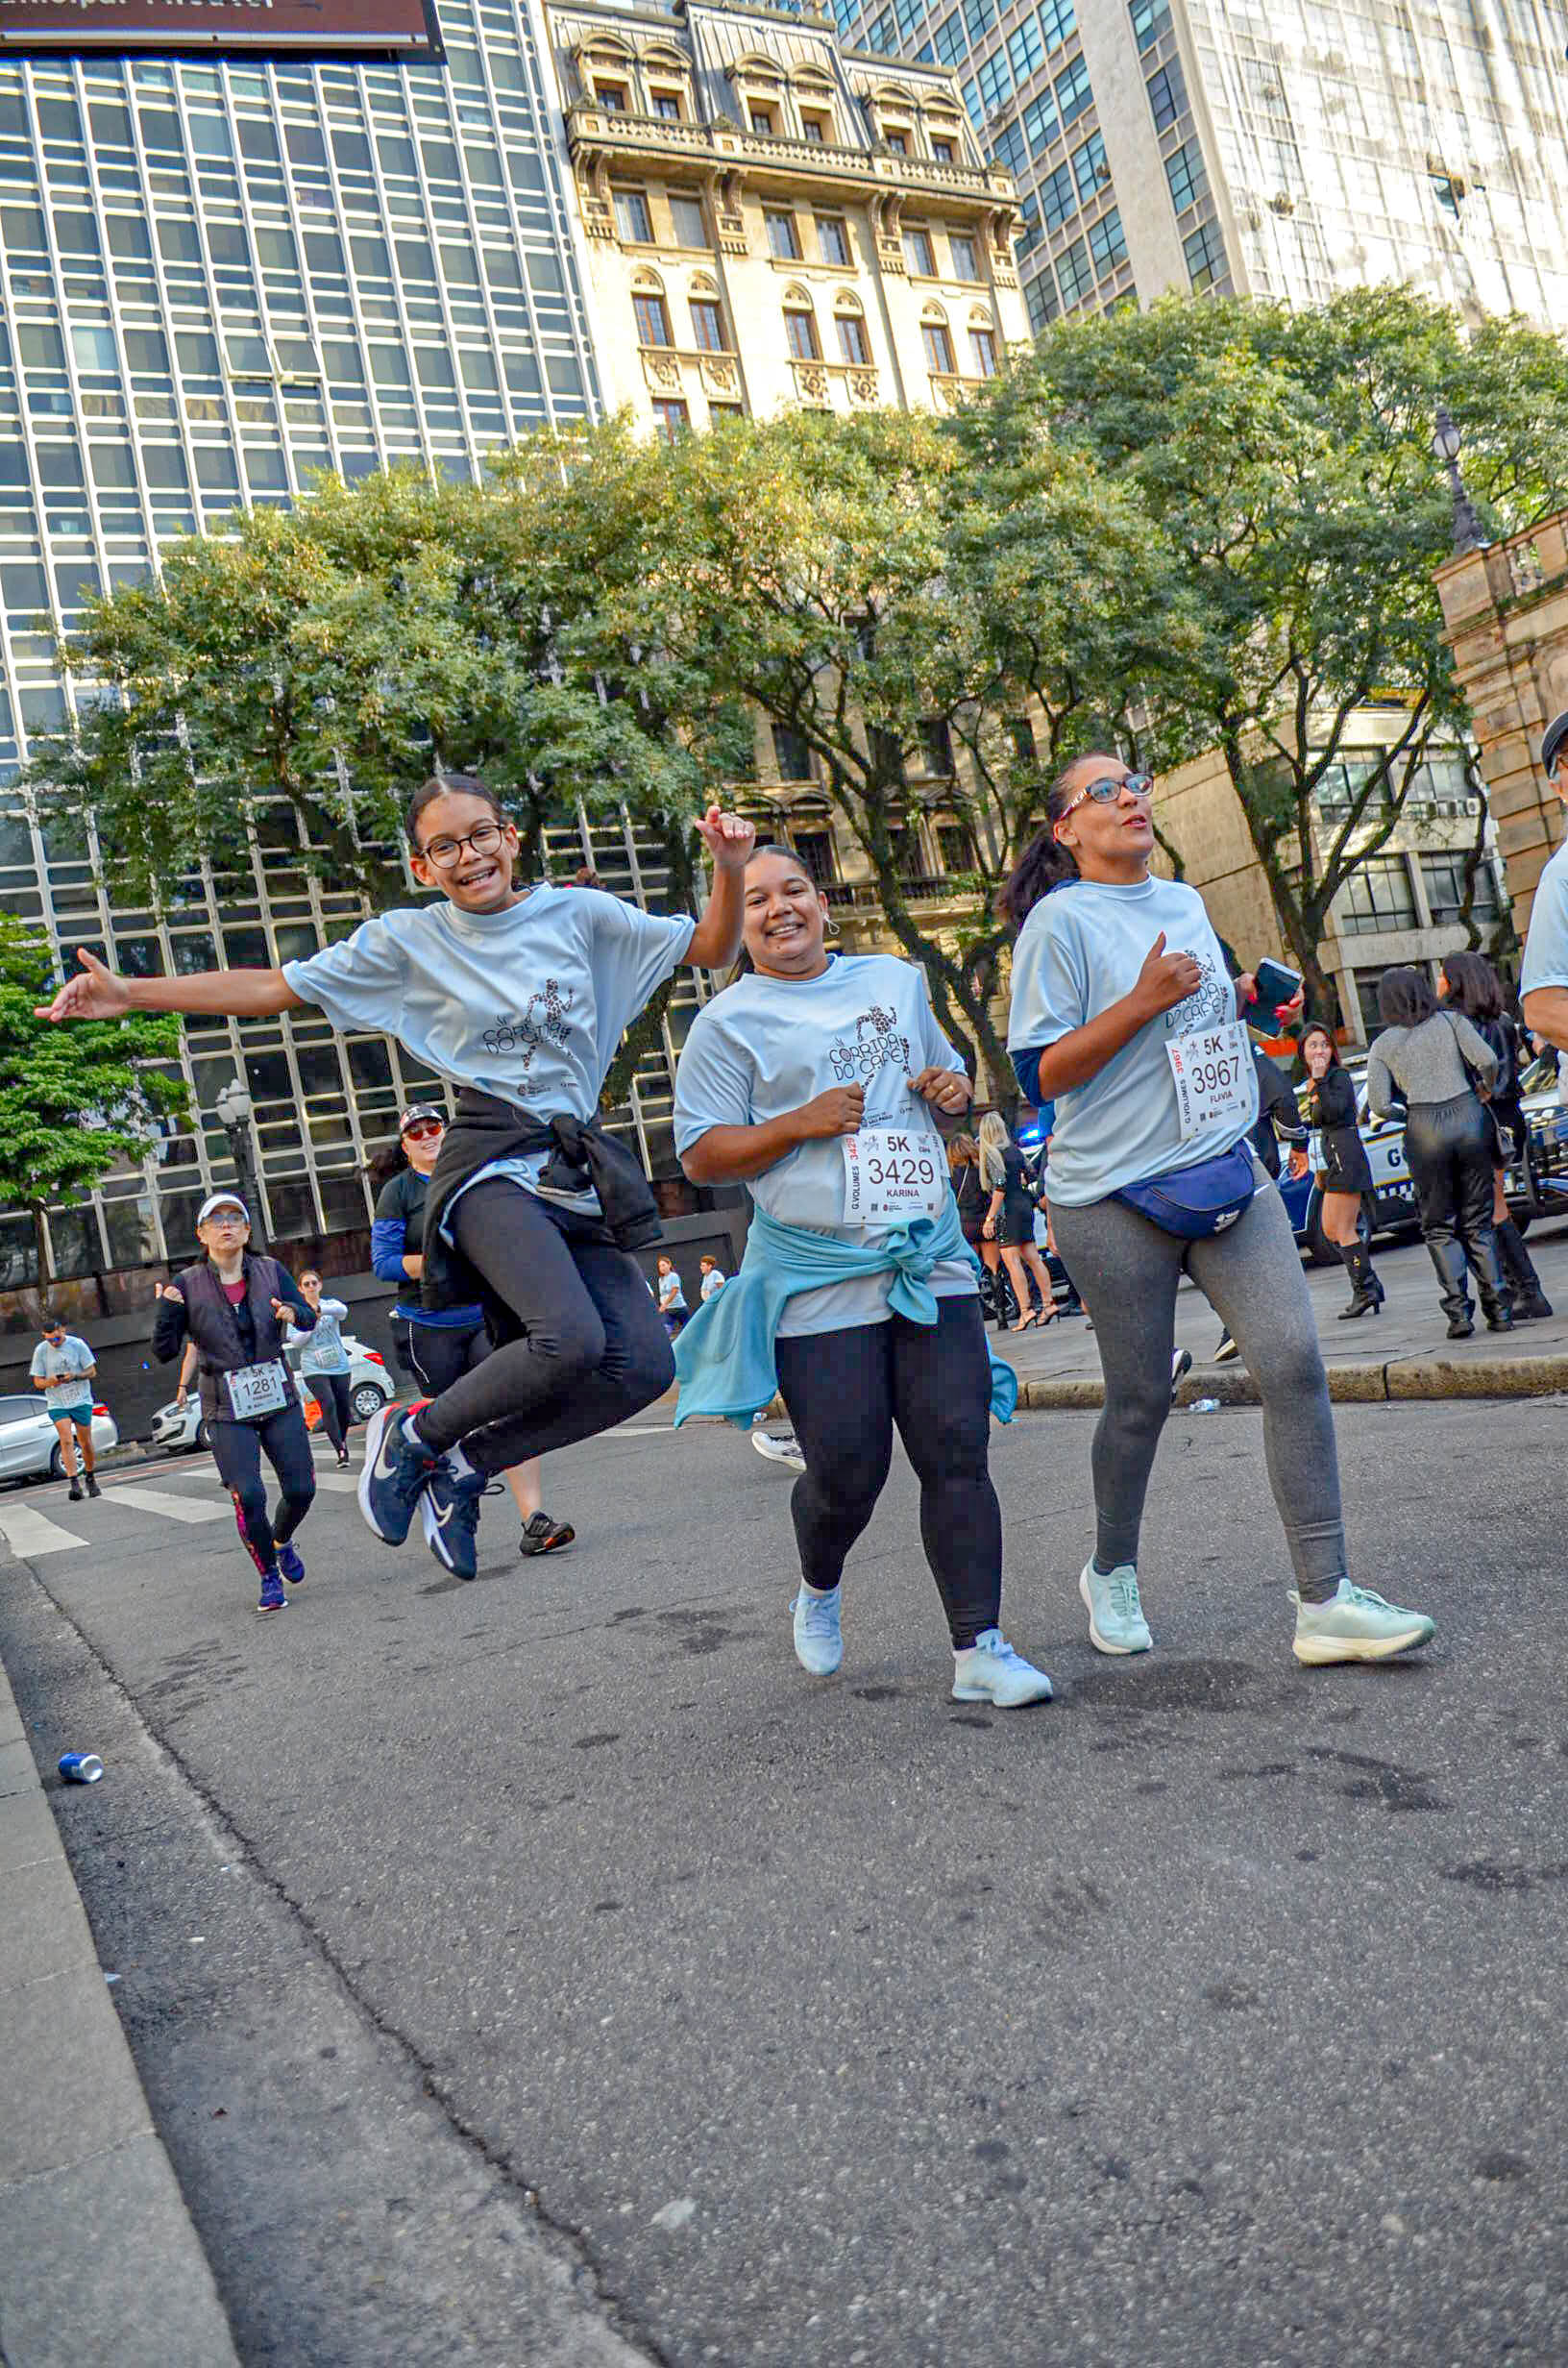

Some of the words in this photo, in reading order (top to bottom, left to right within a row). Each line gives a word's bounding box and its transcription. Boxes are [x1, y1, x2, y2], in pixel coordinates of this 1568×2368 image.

[829, 1033, 899, 1064] CORRIDA
[1204, 1034, 1224, 1055] 5K
[834, 1063, 854, 1080] DO
[1191, 1055, 1239, 1094] 3967
[887, 1136, 911, 1152] 5K
[868, 1158, 934, 1185] 3429
[886, 1189, 919, 1197] KARINA
[242, 1376, 277, 1395] 1281
